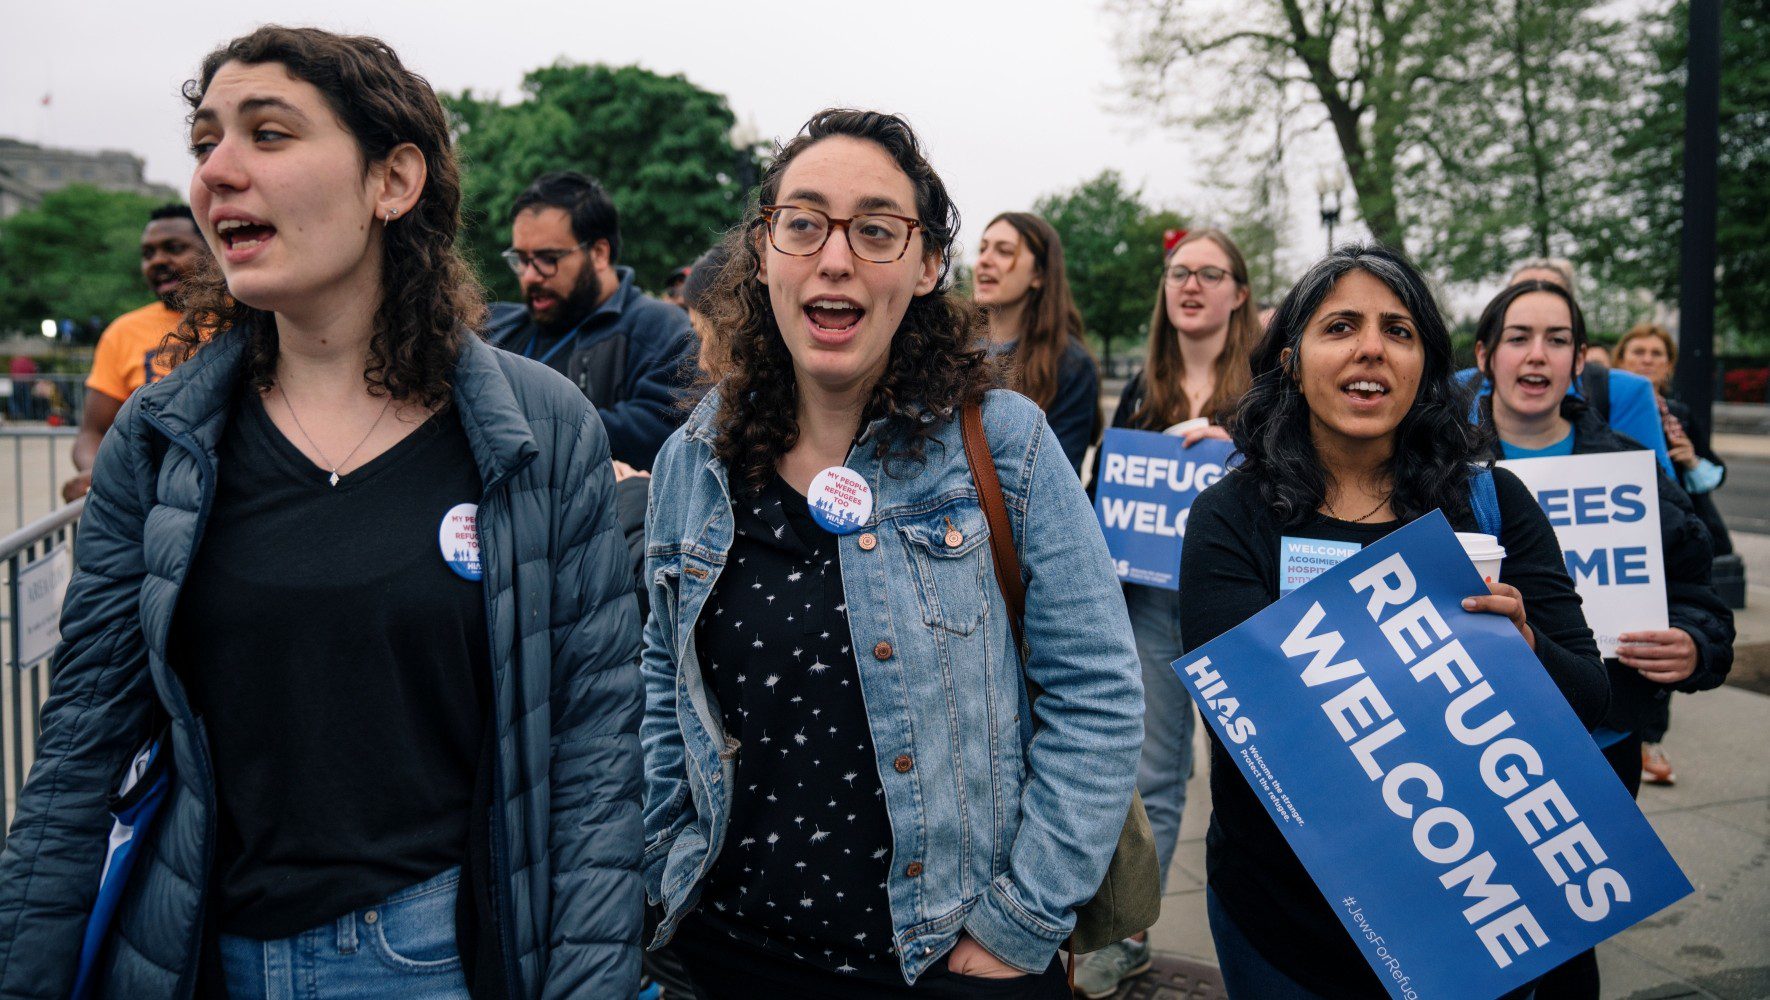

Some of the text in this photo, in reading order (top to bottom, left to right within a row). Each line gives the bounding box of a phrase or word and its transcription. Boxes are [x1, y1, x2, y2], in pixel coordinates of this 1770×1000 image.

[827, 471, 868, 493] MY PEOPLE
[835, 482, 857, 496] WERE
[1104, 453, 1232, 492] REFUG
[824, 485, 862, 505] REFUGEES
[833, 496, 849, 508] TOO
[825, 513, 845, 526] HIAS
[1288, 543, 1356, 557] WELCOME
[1184, 655, 1257, 744] HIAS
[1348, 552, 1632, 923] REFUGEES
[1240, 748, 1290, 823] Protect the refugee.
[1249, 744, 1305, 827] Welcome the stranger.
[1280, 601, 1549, 969] WELCOME
[1342, 896, 1418, 1000] #JewsForRefug
